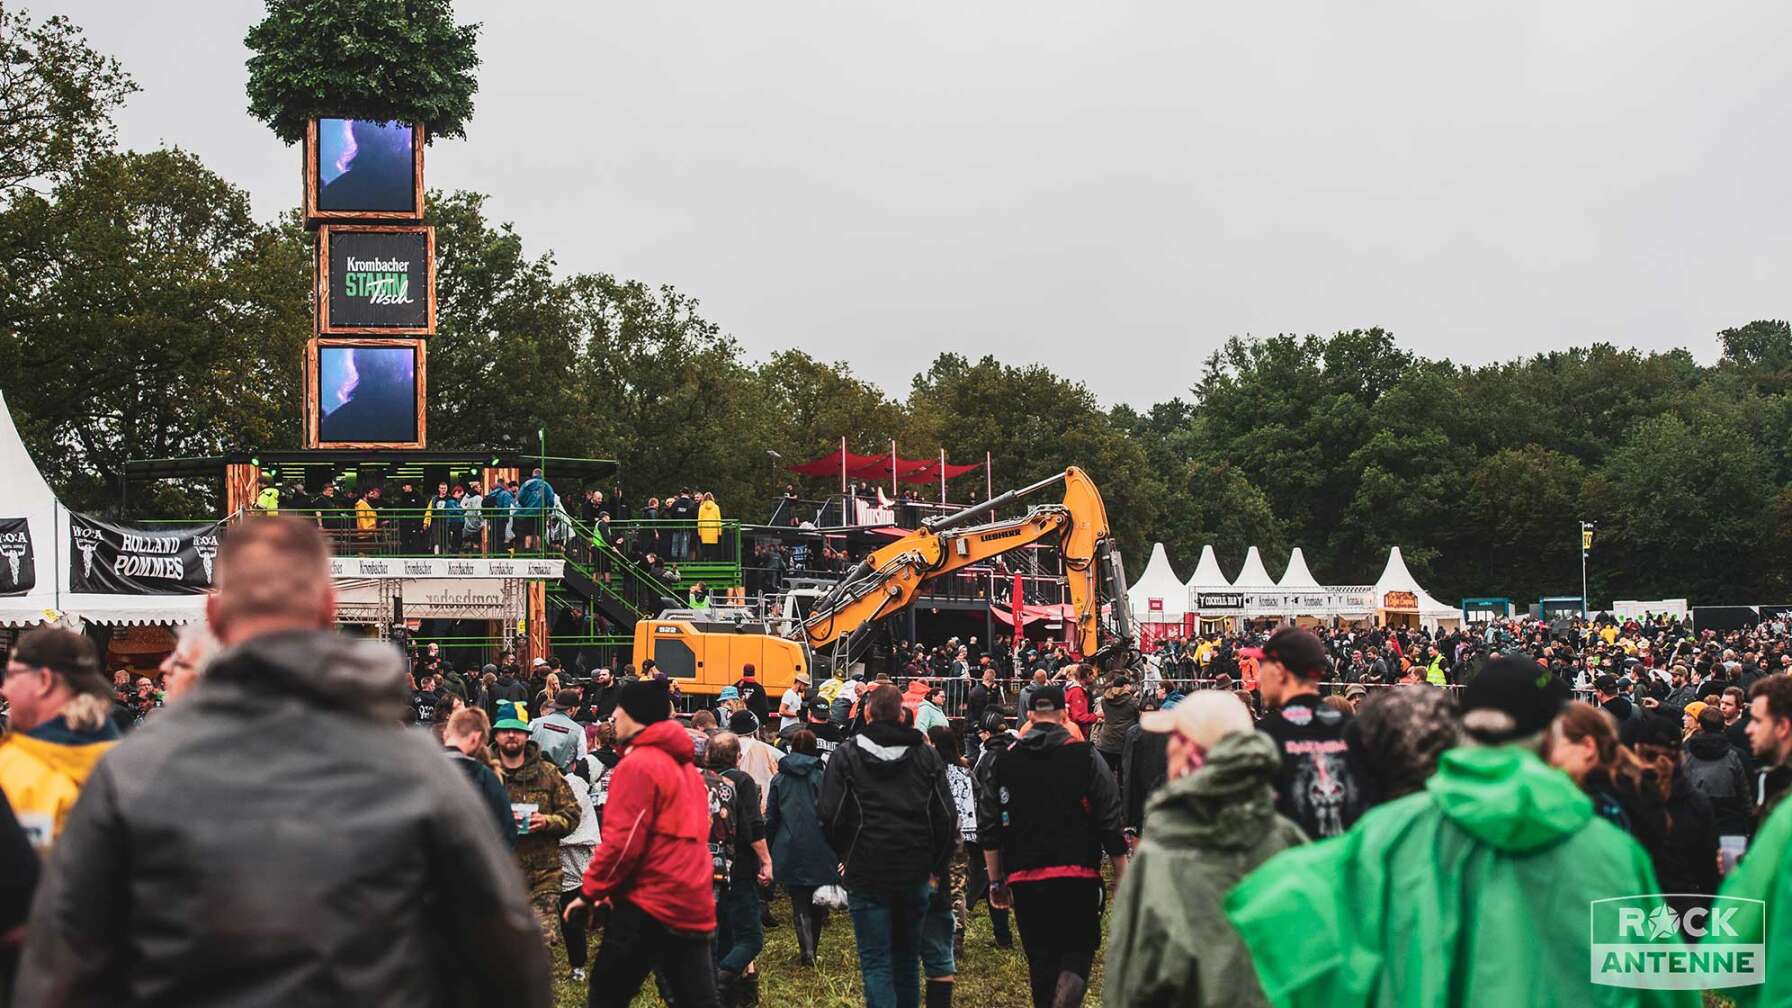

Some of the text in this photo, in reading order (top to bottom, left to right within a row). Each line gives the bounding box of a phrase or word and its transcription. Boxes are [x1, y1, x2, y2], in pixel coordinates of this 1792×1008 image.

[346, 256, 410, 272] Krombacher
[345, 272, 408, 296] STAMM
[366, 278, 414, 305] Tisch
[122, 533, 181, 554] HOLLAND
[980, 528, 1021, 542] LIEBHERR
[114, 554, 184, 580] POMMES
